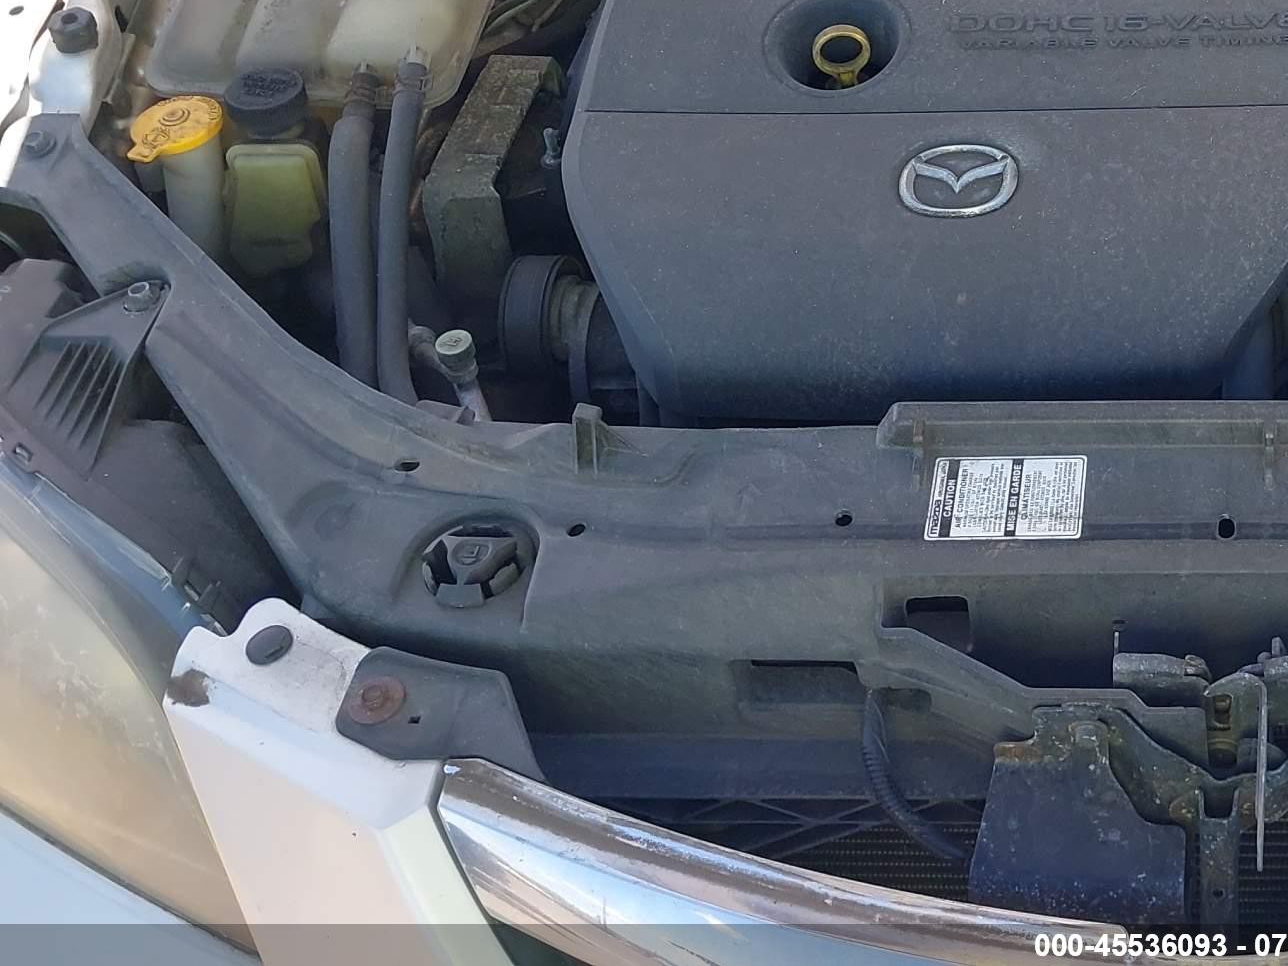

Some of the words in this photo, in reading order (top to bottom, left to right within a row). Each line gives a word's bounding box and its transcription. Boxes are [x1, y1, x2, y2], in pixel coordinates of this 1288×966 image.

[948, 13, 1095, 32] DOHC
[961, 36, 1097, 50] VARIABLE
[1106, 36, 1192, 49] VALVE
[1010, 464, 1021, 493] GARDE
[943, 479, 956, 517] CAUTION
[956, 468, 968, 512] CONDITIONER
[1020, 473, 1032, 520] CLIMATISEUR
[1009, 495, 1018, 507] EN
[954, 516, 962, 528] AIR
[1006, 509, 1016, 530] MISE
